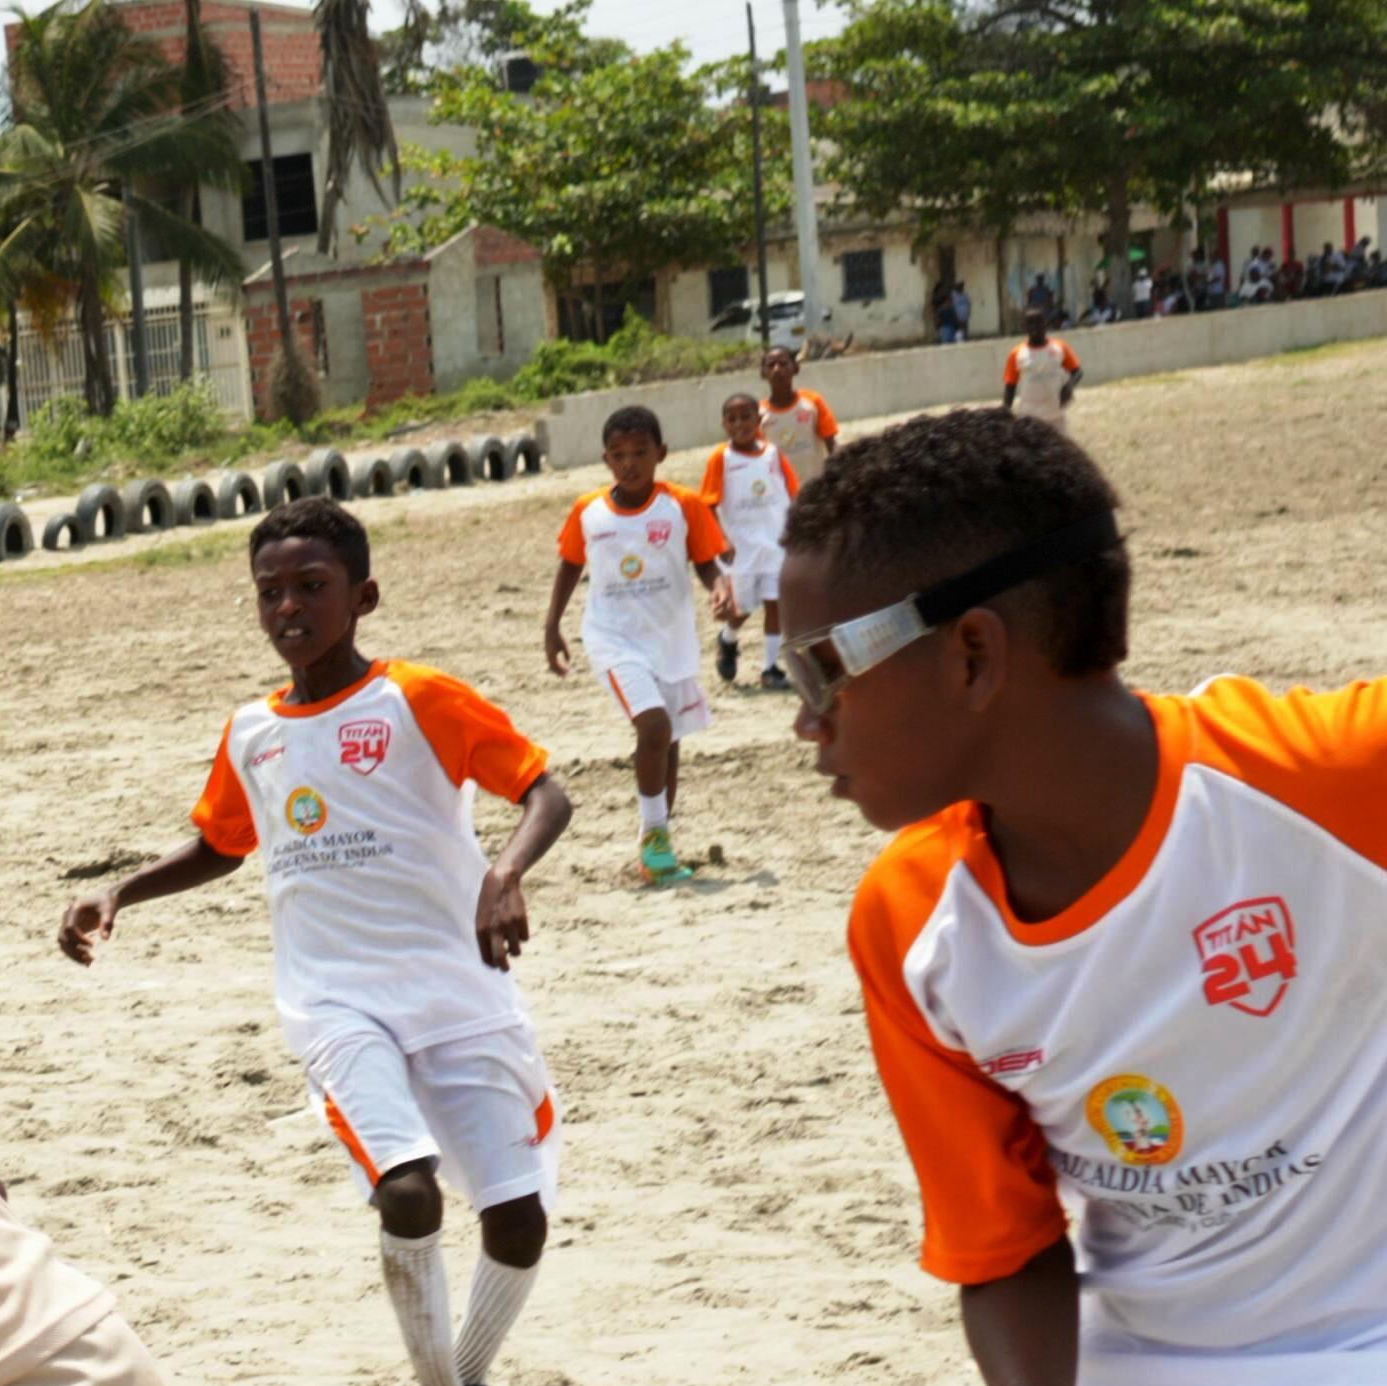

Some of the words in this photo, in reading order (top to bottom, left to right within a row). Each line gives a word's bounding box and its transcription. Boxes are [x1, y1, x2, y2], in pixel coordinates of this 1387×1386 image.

[340, 739, 386, 765] 24
[321, 830, 376, 848] MAYOR
[1205, 907, 1278, 953] TITÁN
[1201, 931, 1298, 1006] 24
[1054, 1150, 1167, 1195] ALALDÍA
[1176, 1193, 1214, 1216] DE
